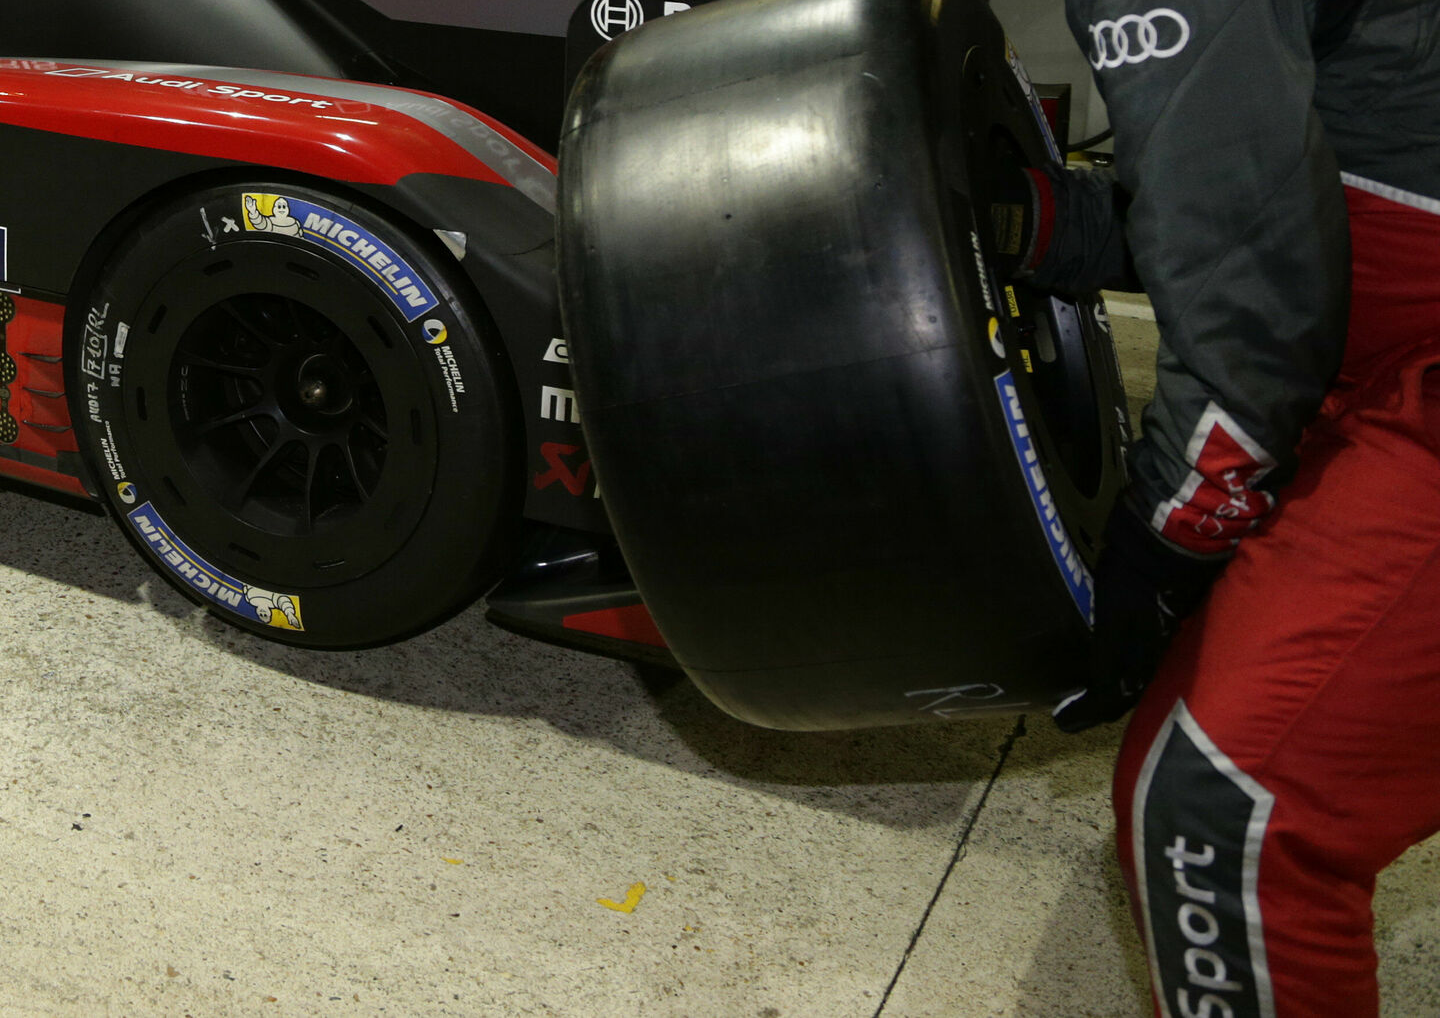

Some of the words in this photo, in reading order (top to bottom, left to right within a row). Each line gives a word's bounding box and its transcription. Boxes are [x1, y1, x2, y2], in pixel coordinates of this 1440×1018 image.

[102, 72, 203, 90] Audi
[207, 84, 334, 110] Sport
[304, 212, 428, 308] MICHELIN
[970, 231, 994, 311] MICHELIN
[434, 347, 445, 364] Total
[440, 365, 459, 413] Performance
[441, 345, 465, 393] MICHELIN
[101, 438, 120, 480] MICHELIN
[105, 420, 121, 464] Performance
[116, 466, 127, 480] Total
[1004, 384, 1085, 588] MICHELIN
[134, 515, 243, 608] MICHELIN
[1164, 835, 1243, 1018] Sport
